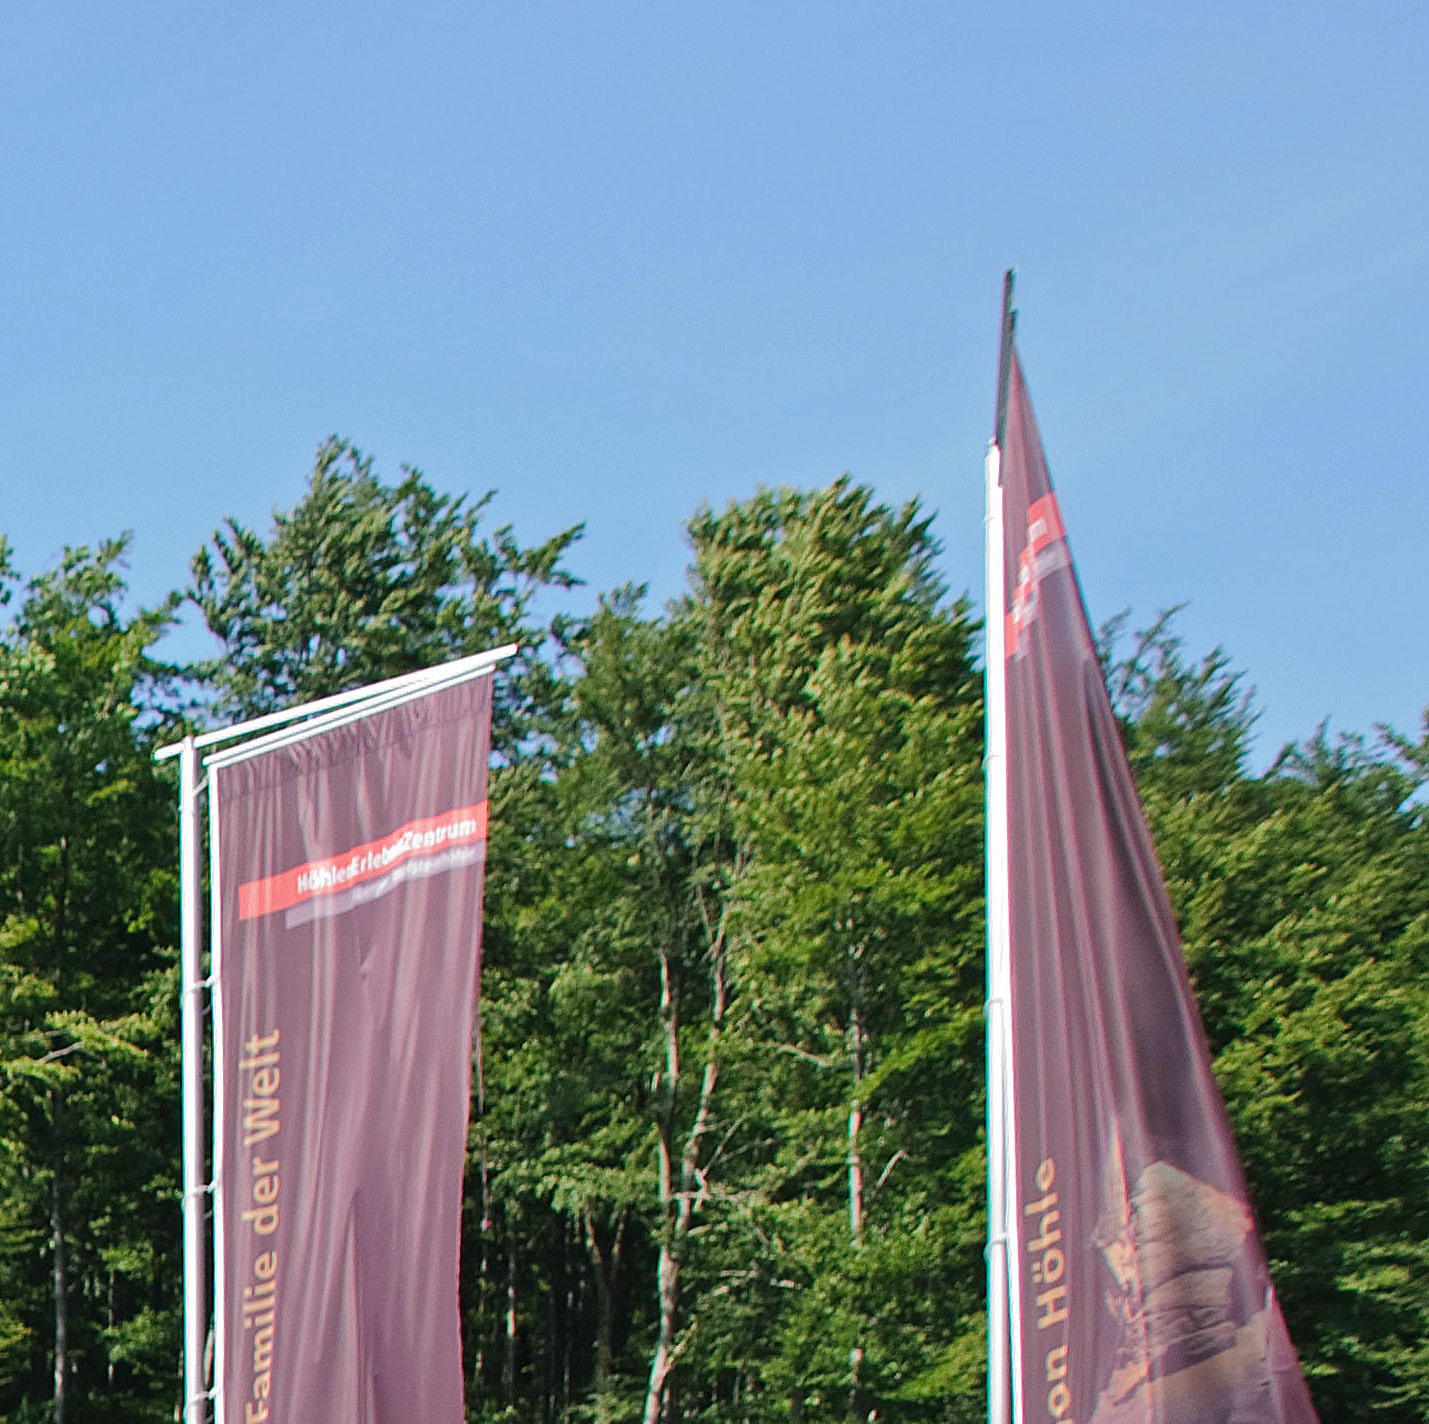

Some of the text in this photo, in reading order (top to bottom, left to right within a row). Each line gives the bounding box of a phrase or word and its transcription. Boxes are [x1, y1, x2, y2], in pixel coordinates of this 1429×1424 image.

[296, 820, 477, 893] HöhlenErlebZentrum
[239, 1029, 281, 1147] Welt
[241, 1157, 280, 1235] der
[1024, 1157, 1069, 1329] Höhle
